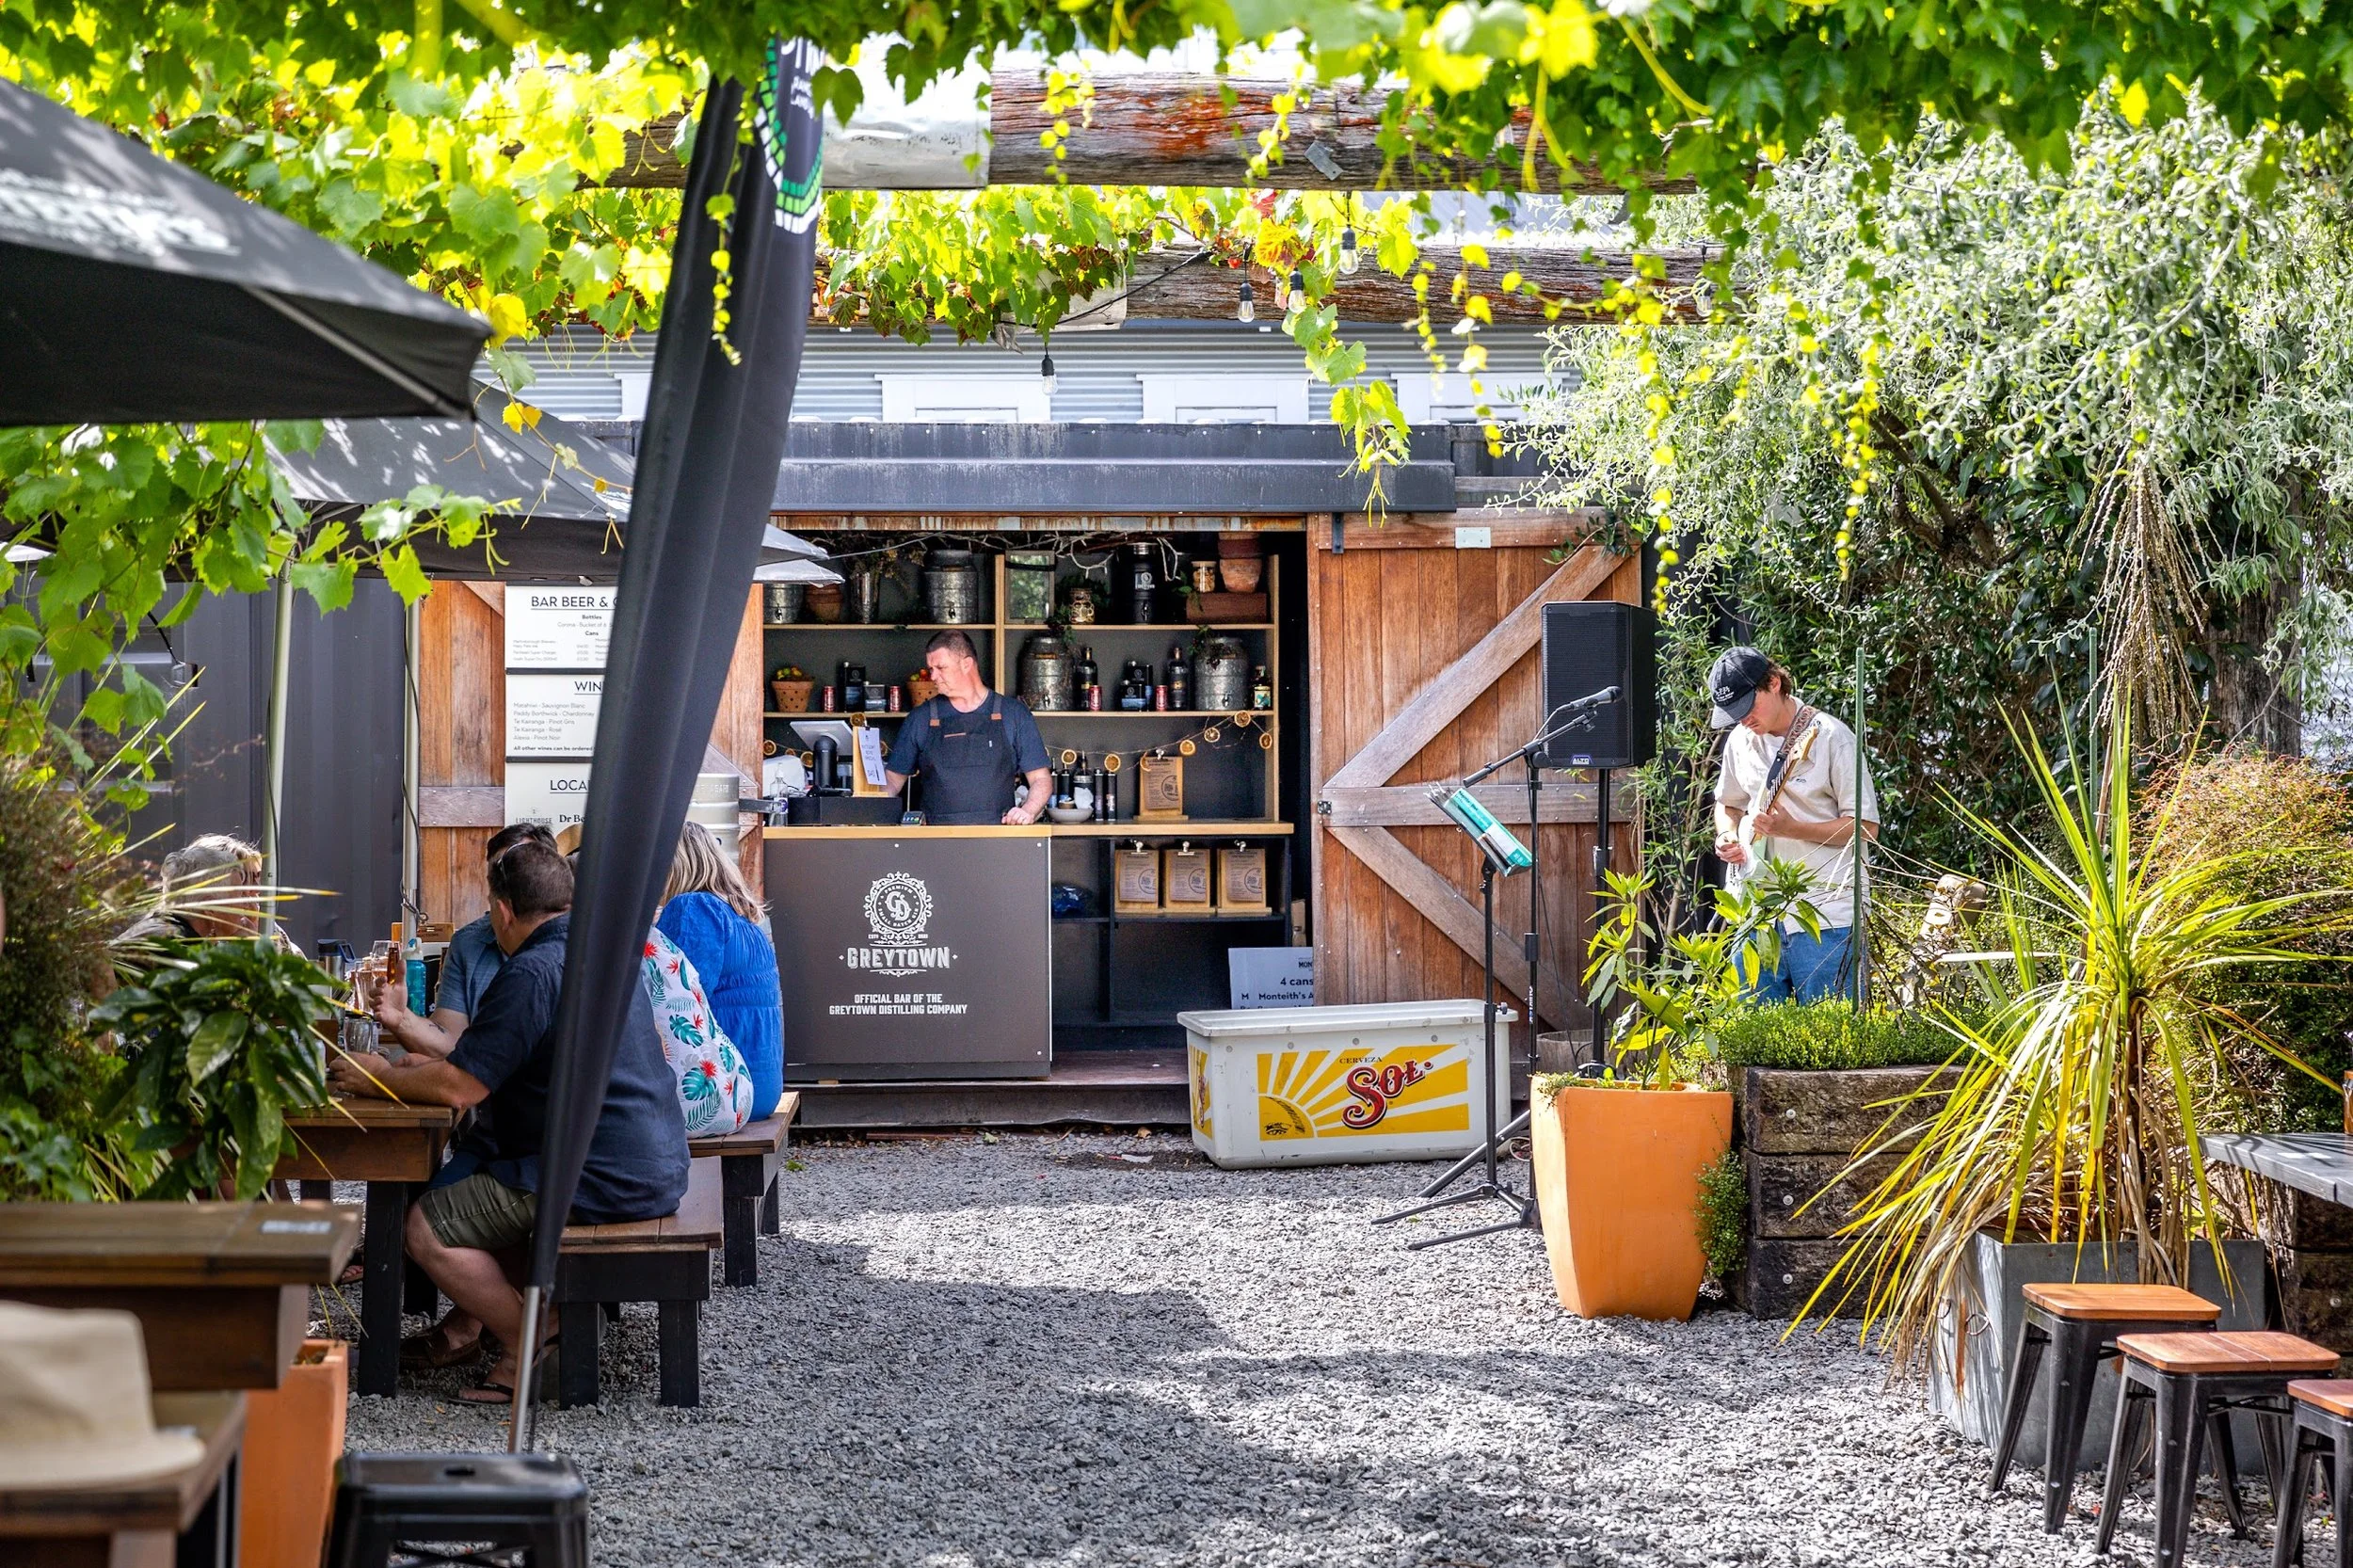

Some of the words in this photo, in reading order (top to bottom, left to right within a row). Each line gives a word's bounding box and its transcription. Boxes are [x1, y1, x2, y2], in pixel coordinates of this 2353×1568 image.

[531, 596, 558, 608] BAR
[561, 596, 595, 608] BEER
[599, 596, 609, 608] &
[574, 680, 603, 692] WIN
[550, 779, 588, 791] LOCA
[559, 814, 572, 823] Dr
[573, 814, 585, 823] Be
[847, 946, 951, 968] GREYTOWN
[1280, 977, 1288, 985] 4
[1289, 978, 1314, 986] cans
[854, 994, 892, 1004] OFFICIAL
[894, 994, 911, 1003] BAR
[912, 993, 924, 1003] OF
[926, 993, 943, 1003] THE
[1258, 991, 1306, 1000] Monteith's
[829, 1005, 877, 1016] GREYTOWN
[878, 1005, 925, 1015] DISTILLING
[926, 1004, 968, 1015] COMPANY
[1339, 1056, 1383, 1064] CERVEZA
